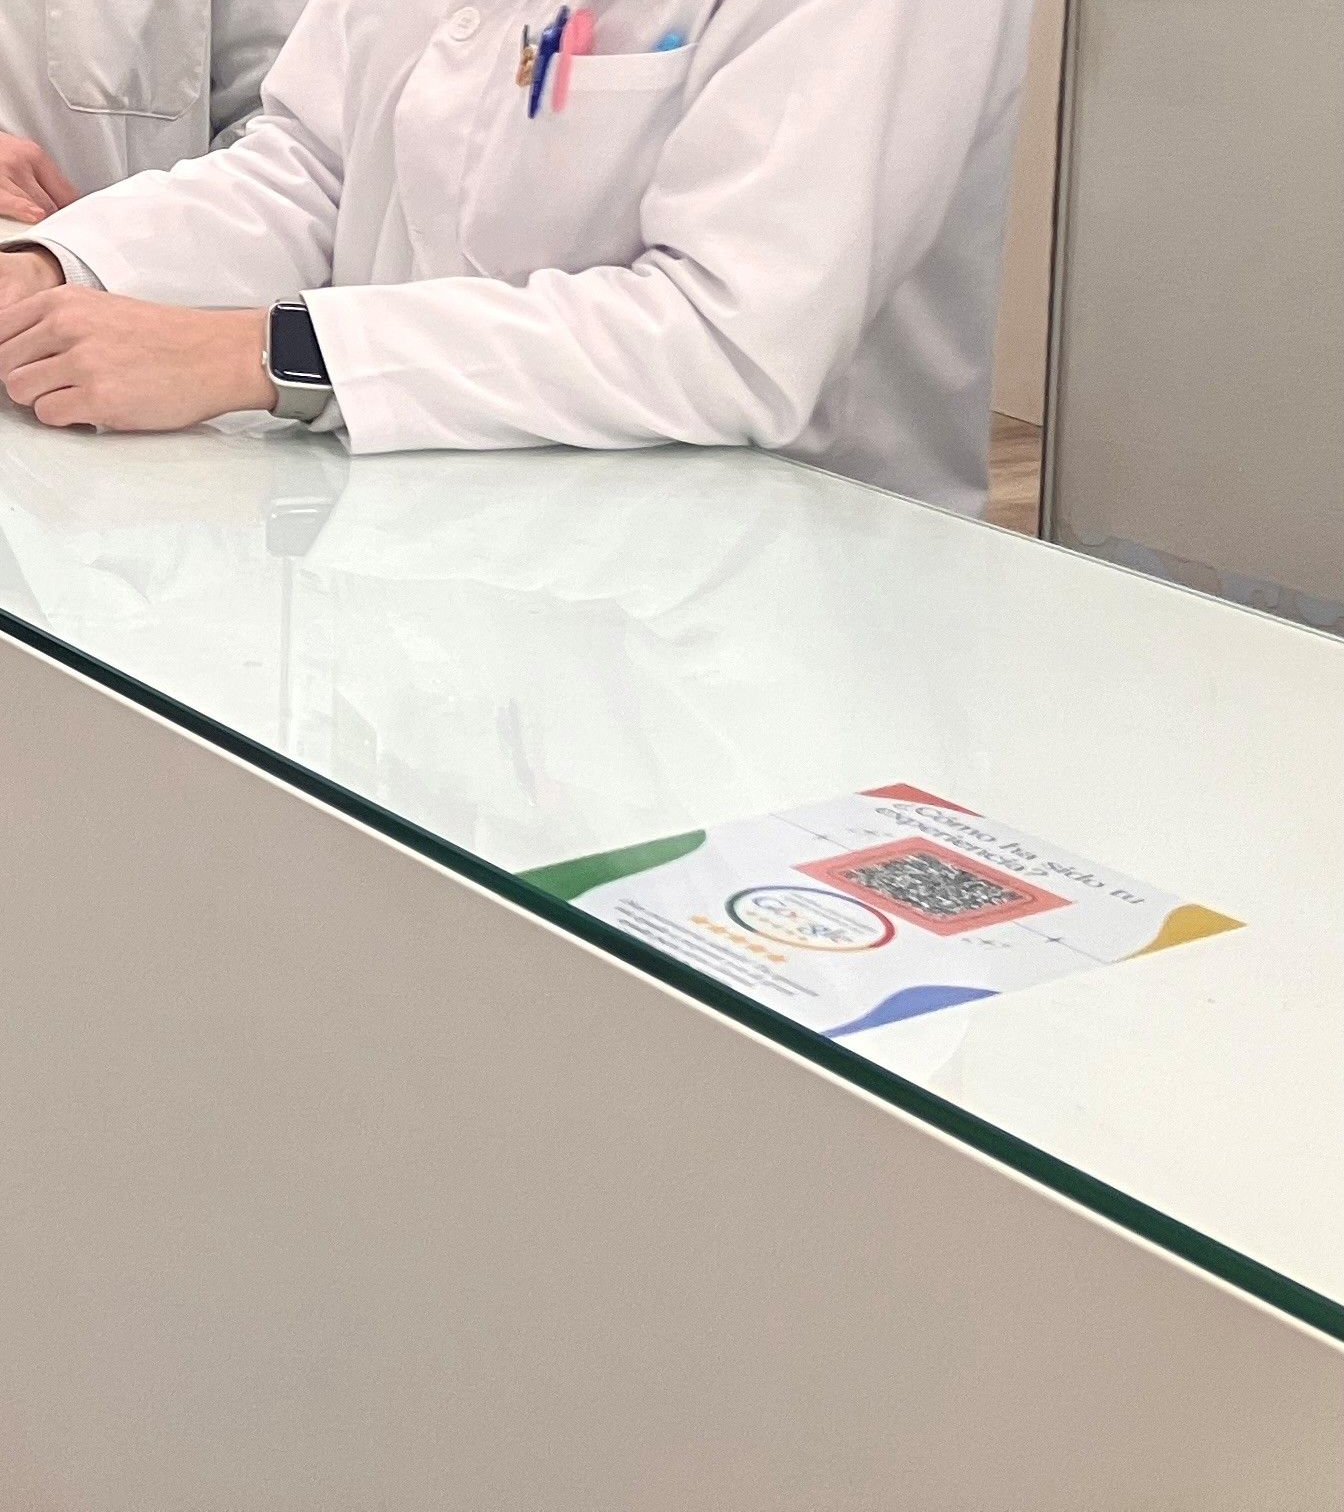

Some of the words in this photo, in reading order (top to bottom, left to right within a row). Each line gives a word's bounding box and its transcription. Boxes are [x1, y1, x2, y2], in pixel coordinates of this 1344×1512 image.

[999, 842, 1038, 861] ha
[1044, 860, 1105, 890] sido
[1110, 888, 1146, 905] tu
